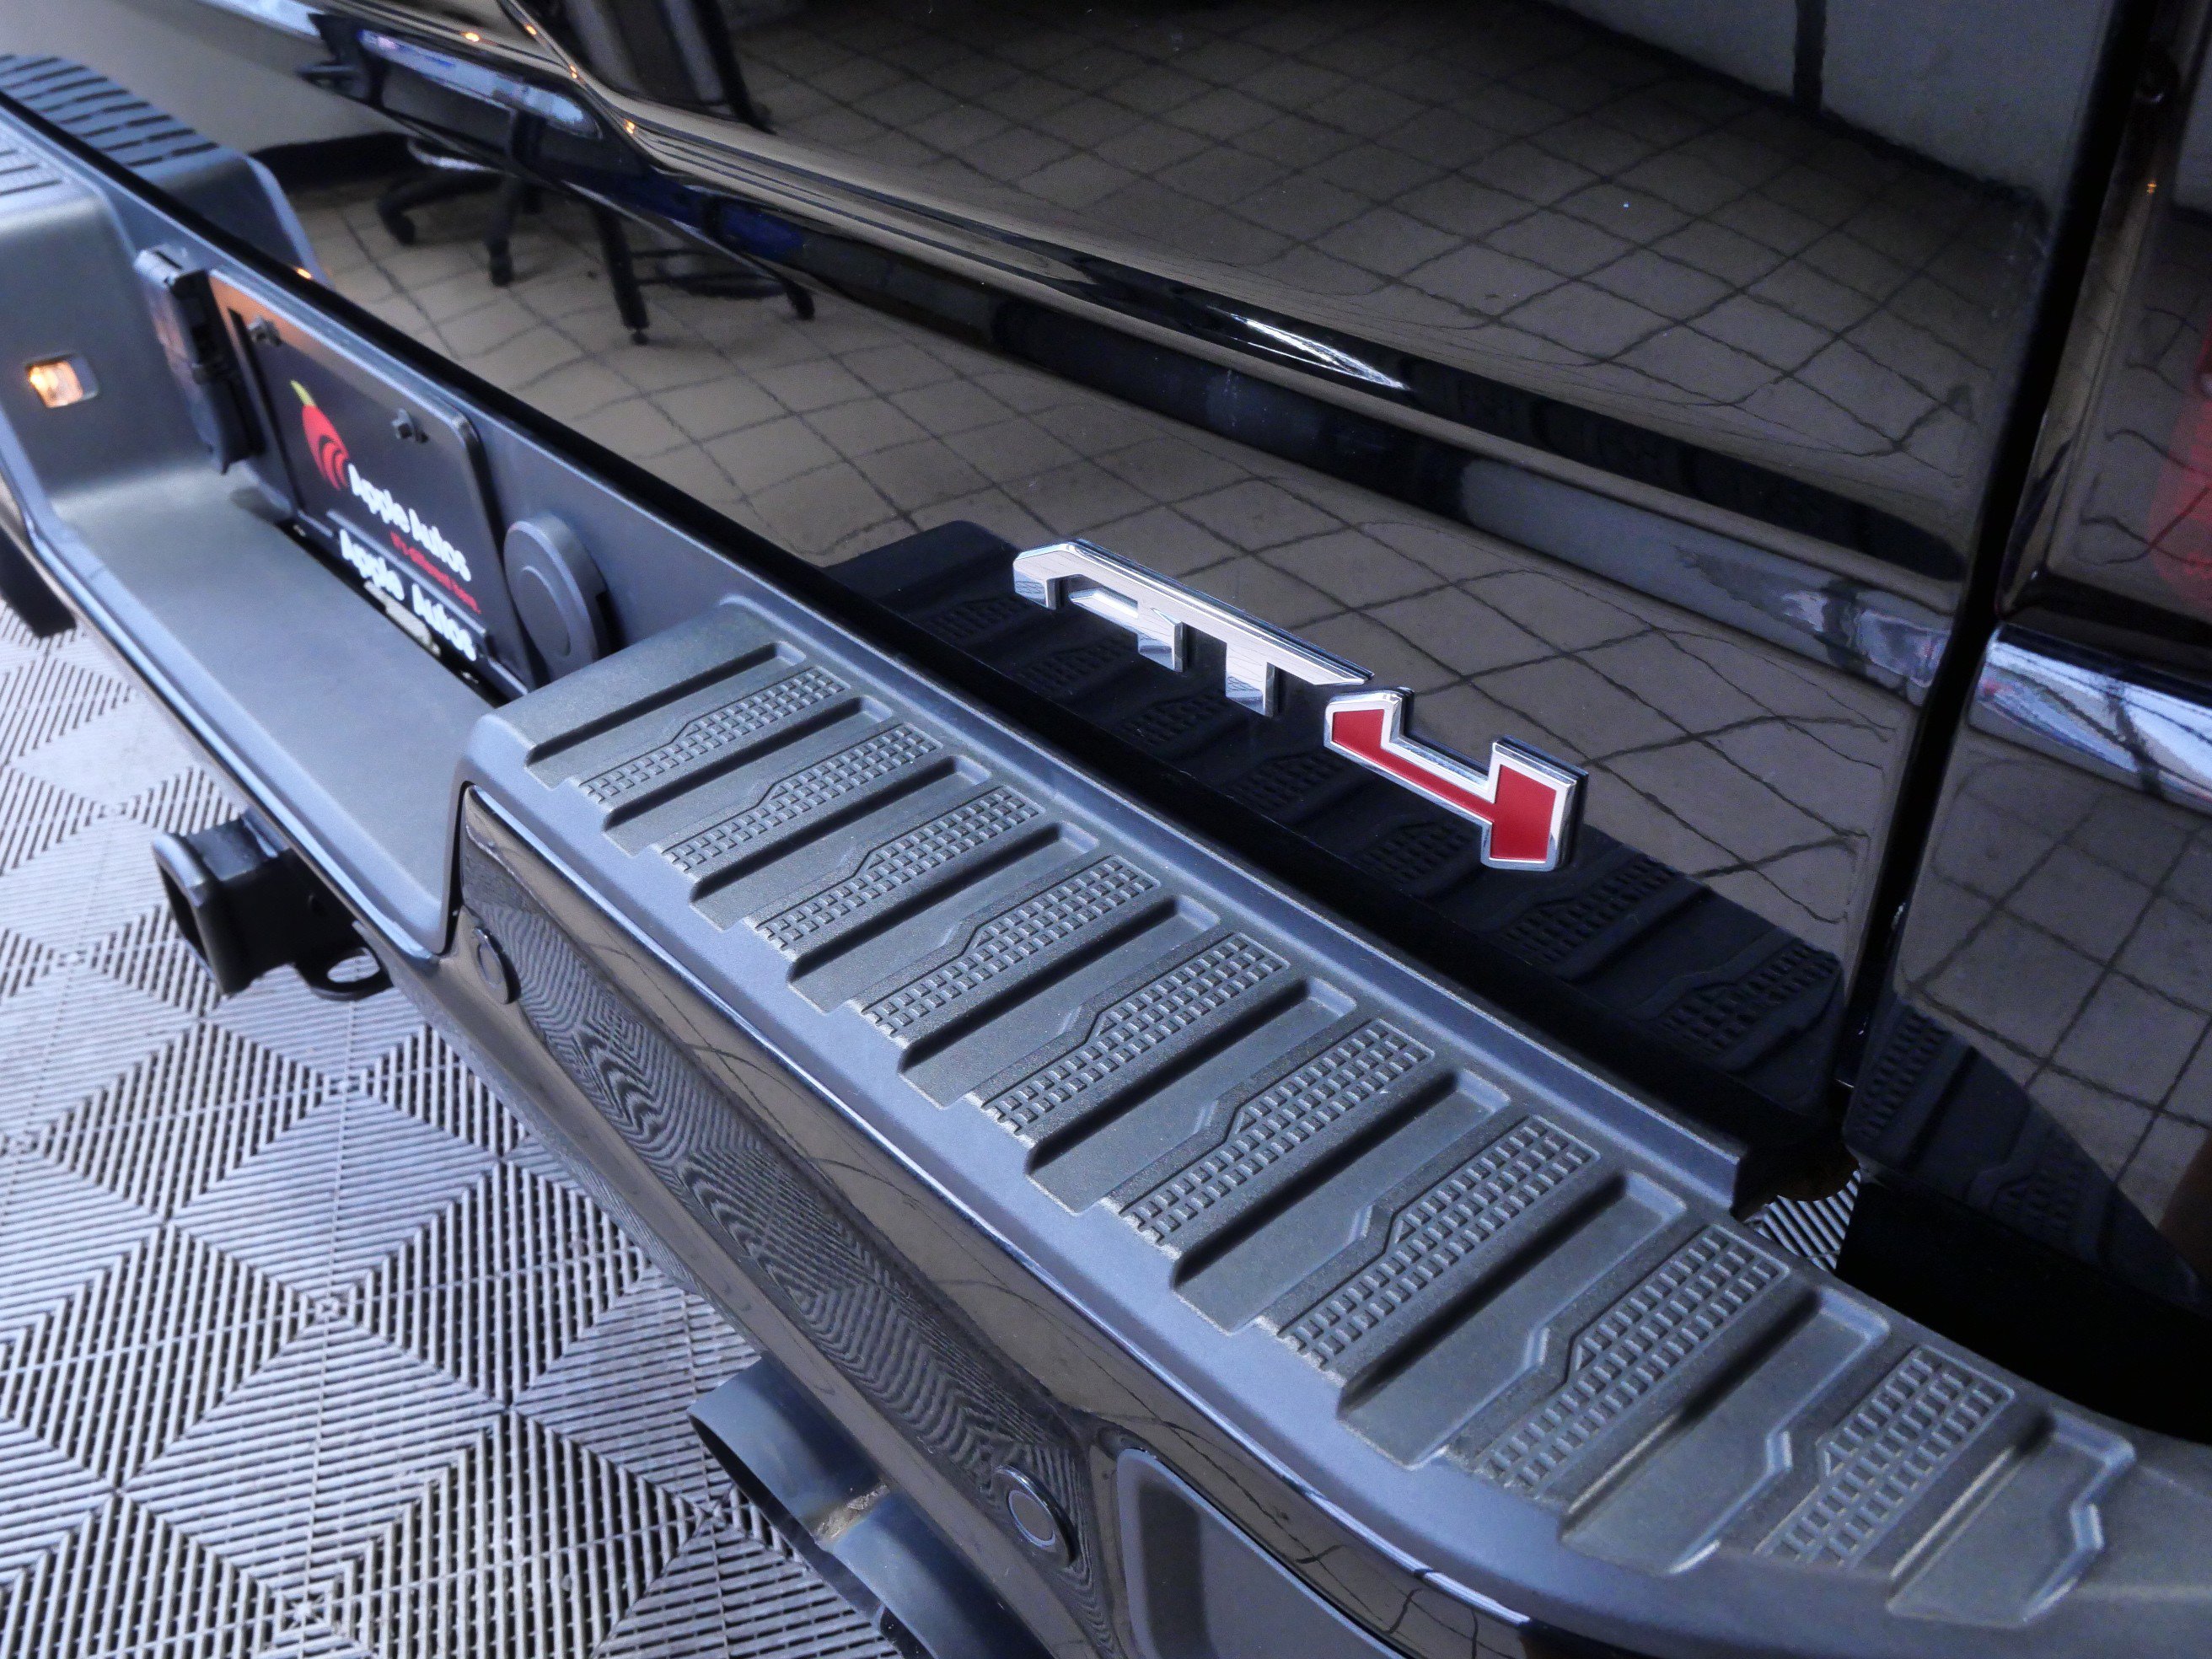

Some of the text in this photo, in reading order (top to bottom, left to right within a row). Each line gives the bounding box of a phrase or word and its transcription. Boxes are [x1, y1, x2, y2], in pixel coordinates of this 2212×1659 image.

[347, 464, 410, 534] Apple
[408, 508, 472, 582] Autos
[339, 529, 405, 601] Apple
[411, 583, 477, 662] Autos
